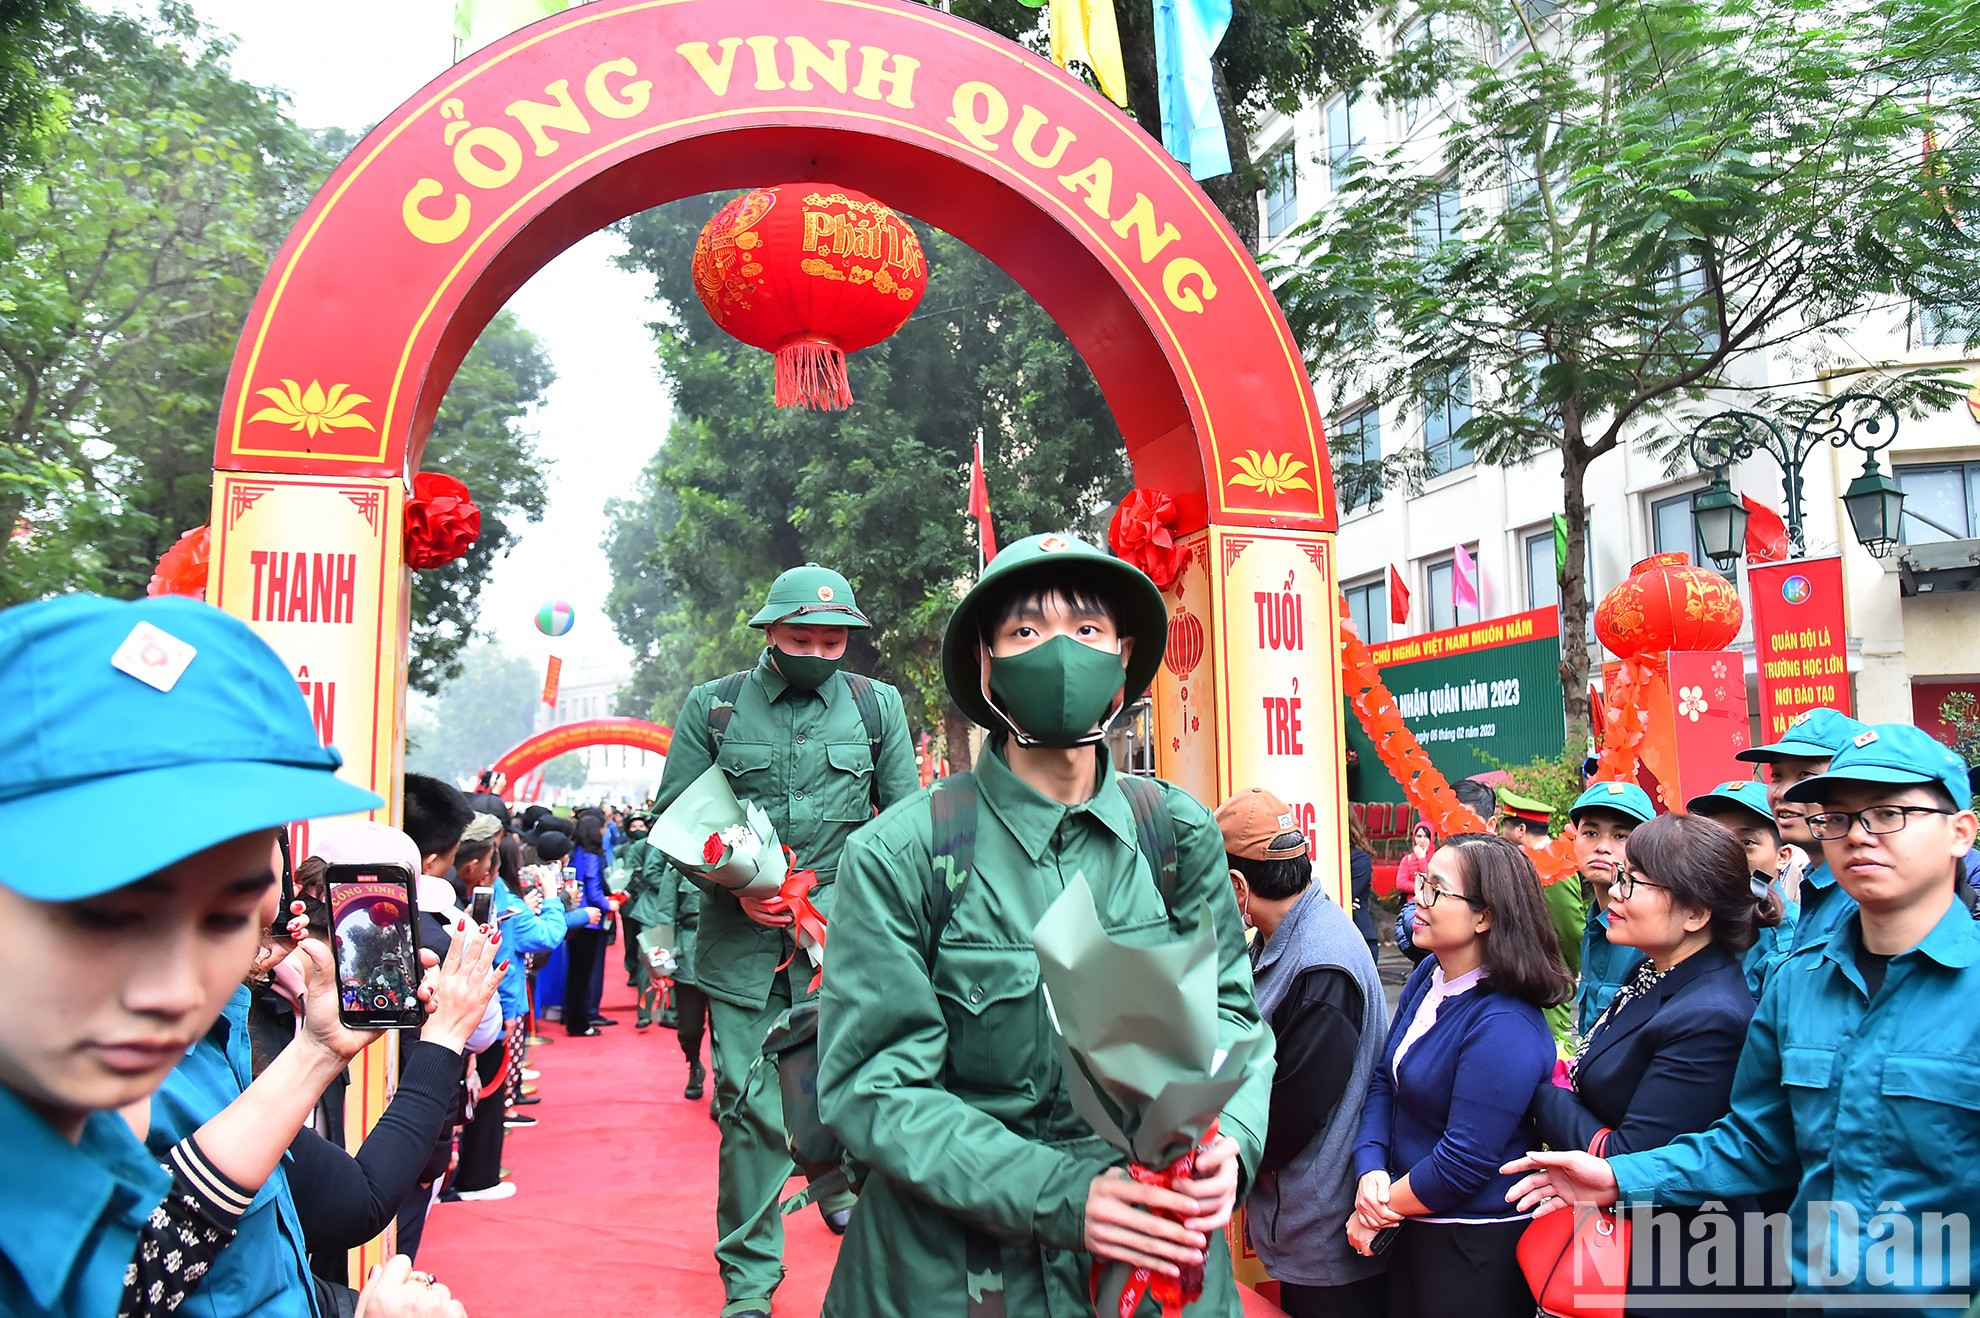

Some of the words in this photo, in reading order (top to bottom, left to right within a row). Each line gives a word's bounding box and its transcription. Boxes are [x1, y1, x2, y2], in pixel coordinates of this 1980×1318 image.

[402, 57, 653, 244] CỔNG
[675, 35, 921, 109] VINH
[945, 81, 1218, 314] QUANG
[803, 211, 882, 260] Phát
[250, 550, 356, 624] THANH
[1254, 569, 1304, 651] TUỔI
[1372, 644, 1391, 665] CHỦ
[1422, 636, 1444, 657] VIỆT
[1445, 634, 1470, 652] NAM
[1471, 623, 1504, 647] MUÔN
[1506, 618, 1533, 639] NĂM
[1771, 629, 1798, 651] QUÂN
[1799, 630, 1817, 652] ĐỘI
[1818, 626, 1831, 647] LÀ
[1764, 657, 1801, 679] TRƯỜNG
[1802, 658, 1822, 680] HỌC
[1824, 654, 1844, 674] LỚN
[1262, 676, 1304, 756] TRẺ
[1399, 687, 1429, 722] NHẬN
[1429, 682, 1460, 717] QUÂN
[1461, 679, 1489, 711] NĂM
[1490, 678, 1520, 708] 2023
[1774, 686, 1793, 706] NƠI
[1794, 684, 1814, 704] ĐÀO
[1816, 684, 1835, 707] TẠO
[1456, 726, 1465, 740] 02
[1465, 725, 1480, 738] năm
[1479, 723, 1496, 737] 2023
[1772, 712, 1787, 733] VÀ
[365, 885, 395, 896] VINH
